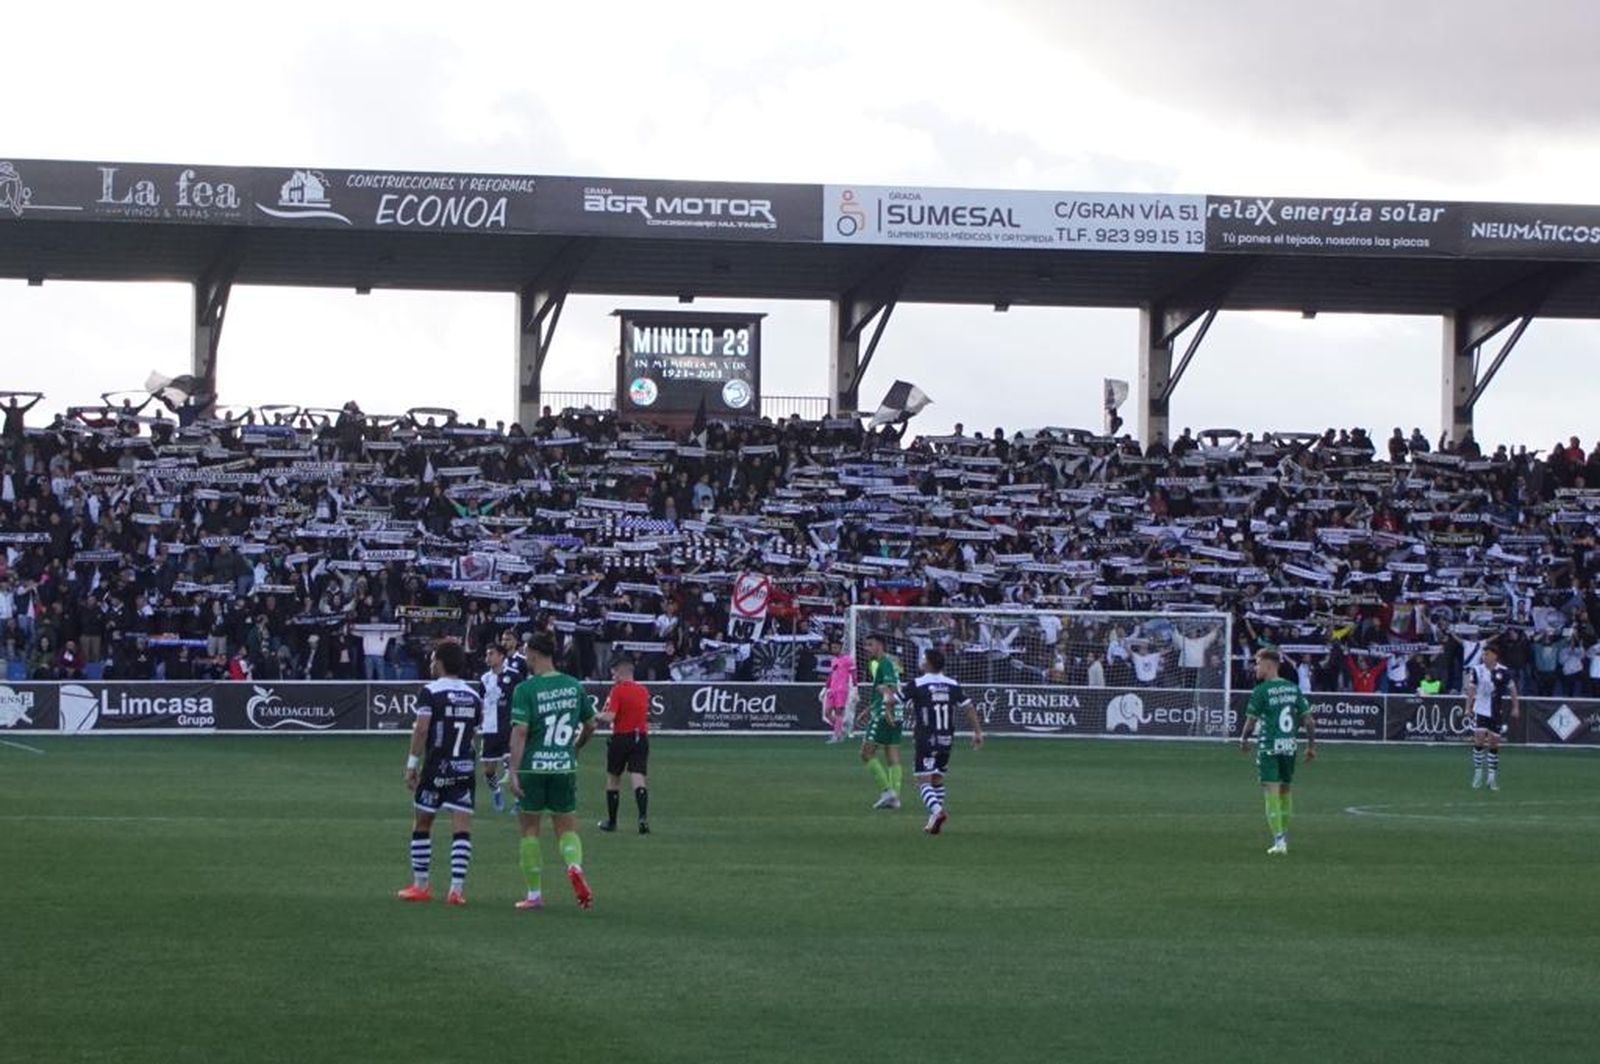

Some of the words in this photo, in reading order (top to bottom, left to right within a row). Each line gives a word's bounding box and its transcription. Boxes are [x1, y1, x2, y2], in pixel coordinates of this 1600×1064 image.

[96, 167, 160, 206] La
[175, 168, 241, 209] fea
[346, 174, 453, 190] CONSTRUCCIONES
[460, 177, 468, 191] Y
[469, 177, 536, 193] REFORMAS
[888, 192, 921, 201] GRADA
[375, 194, 509, 228] ECONOA
[655, 197, 776, 222] MOTOR
[887, 204, 1021, 228] SUMESAL
[1055, 202, 1136, 222] C/GRAN
[1140, 200, 1175, 221] VÍA
[1179, 204, 1199, 221] 51
[1280, 202, 1373, 224] energía
[1380, 203, 1444, 222] solar
[887, 230, 950, 240] SUMINISTROS
[951, 231, 992, 241] MÉDICOS
[994, 233, 1000, 241] Y
[1001, 233, 1053, 243] ORTOPEDIA
[1056, 227, 1090, 243] TLF.
[1095, 229, 1130, 244] 923
[1134, 229, 1157, 244] 99
[1160, 230, 1179, 244] 15
[1186, 230, 1205, 245] 13
[1222, 232, 1235, 244] Tú
[1238, 235, 1271, 246] pones
[1274, 234, 1285, 245] el
[1286, 235, 1323, 248] tejado,
[1326, 236, 1372, 247] nosotros
[1375, 236, 1390, 248] las
[1392, 236, 1430, 249] placas
[1471, 220, 1600, 243] NEUMÁTICOS
[633, 327, 714, 355] MINUTO
[722, 328, 749, 356] 23
[101, 689, 214, 715] Limcasa
[1005, 689, 1080, 708] TERNERA
[1310, 702, 1333, 713] erto
[1336, 701, 1380, 714] Charro
[177, 714, 215, 727] Grupo
[933, 703, 949, 730] 11
[1008, 707, 1077, 726] CHARRA
[1279, 705, 1293, 733] 6
[453, 722, 466, 757] 7
[543, 712, 573, 747] 16
